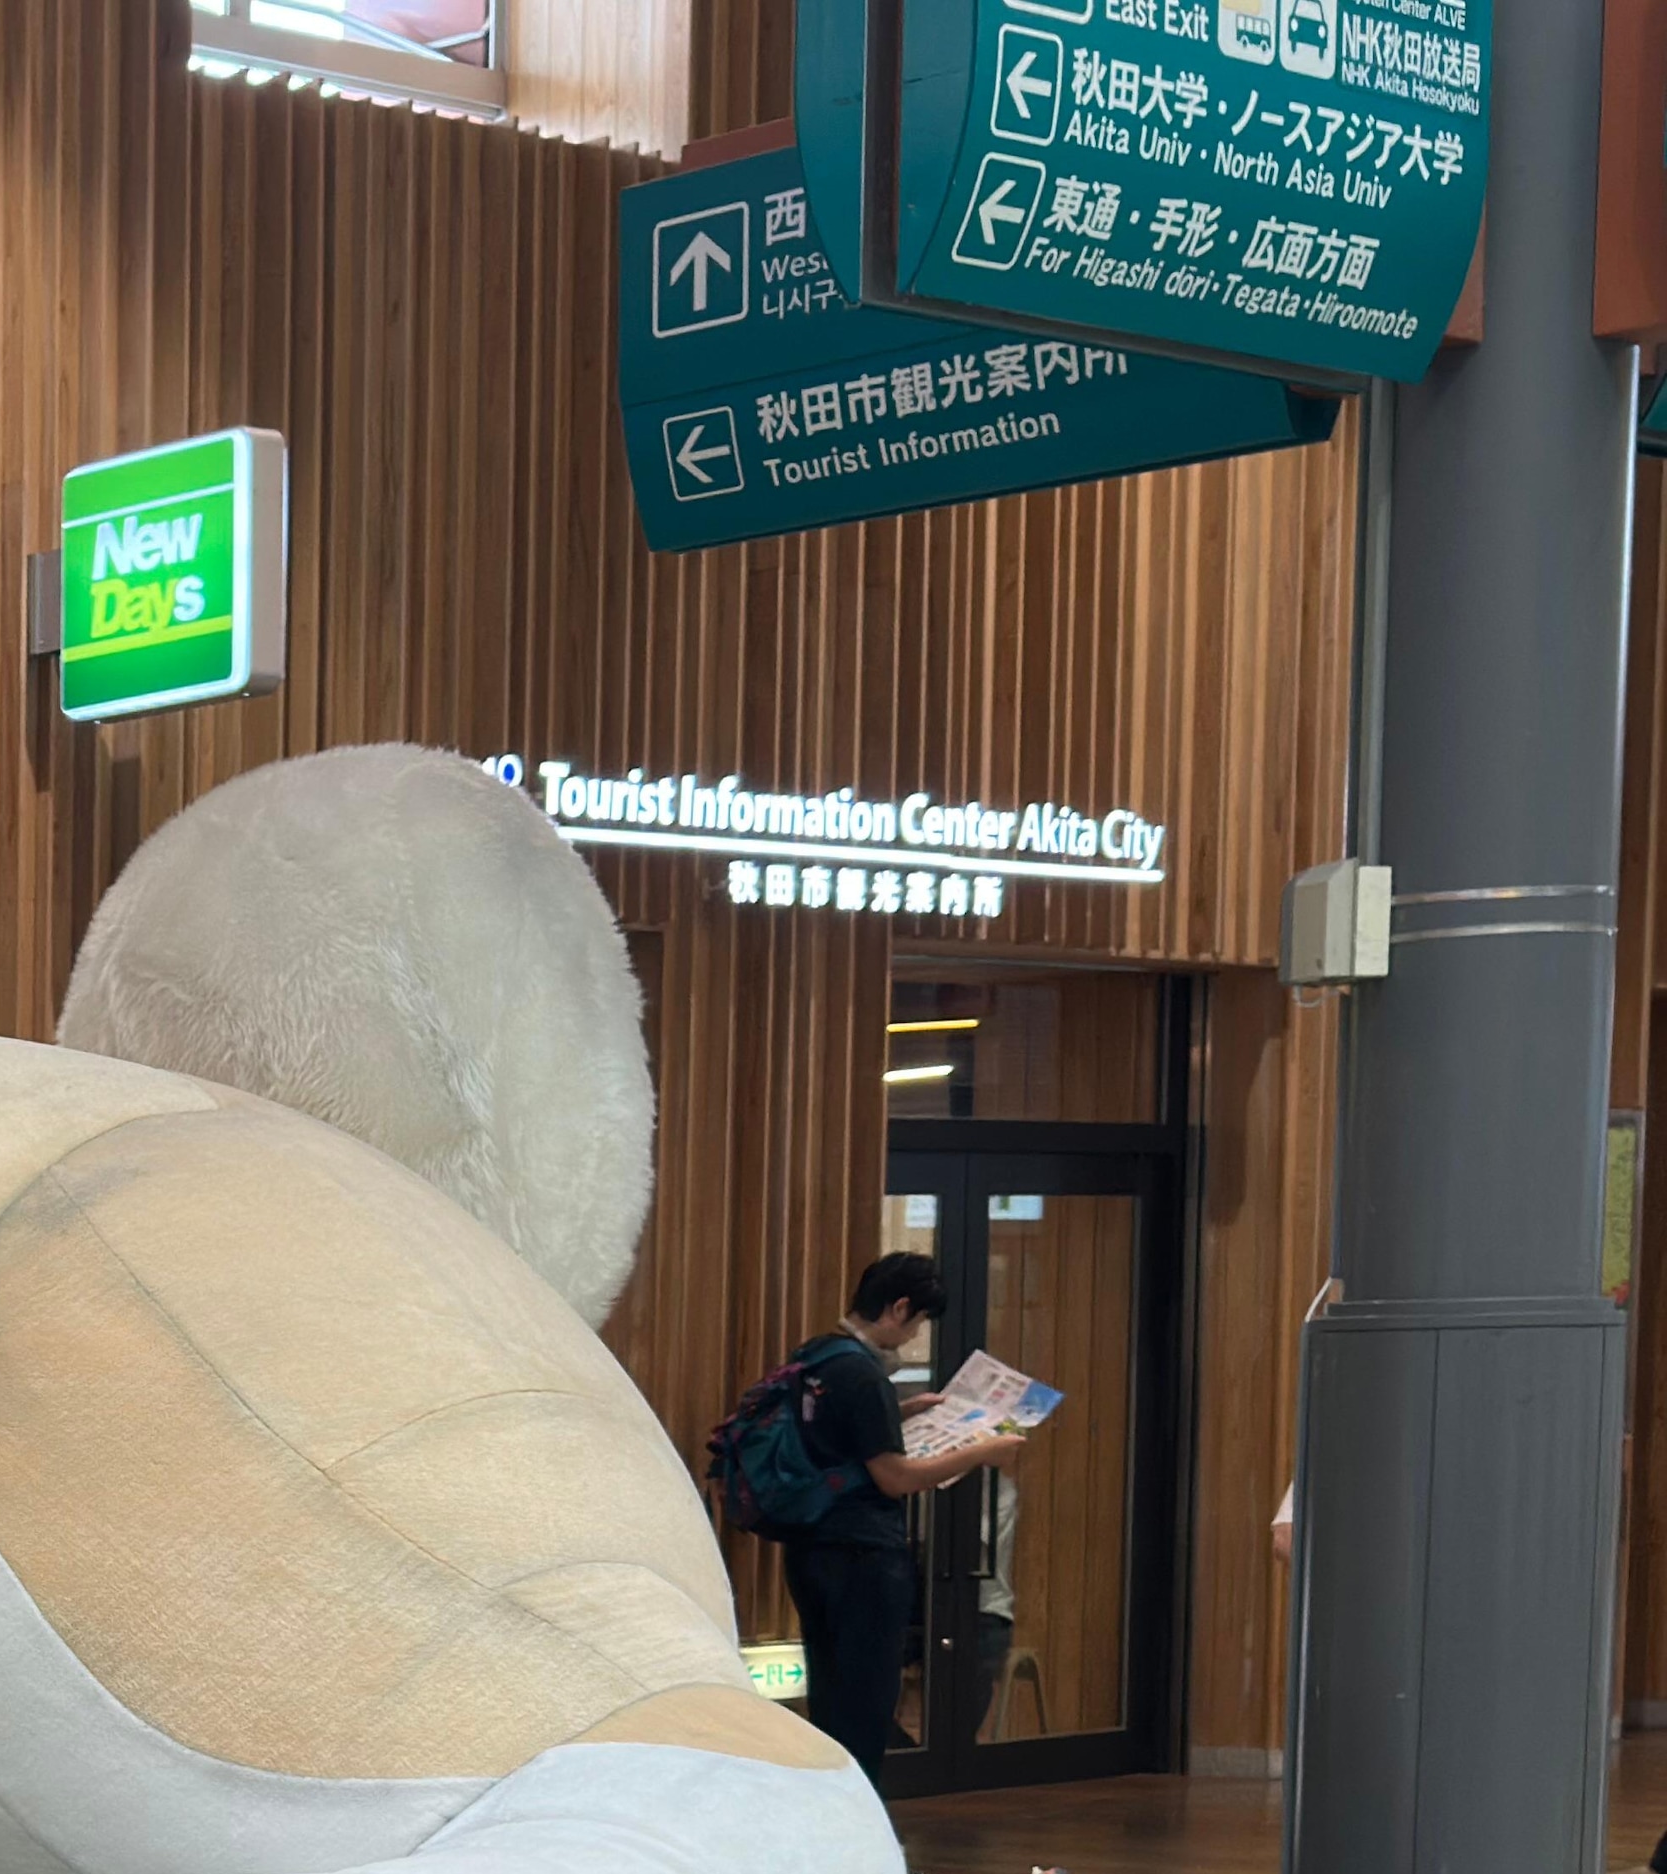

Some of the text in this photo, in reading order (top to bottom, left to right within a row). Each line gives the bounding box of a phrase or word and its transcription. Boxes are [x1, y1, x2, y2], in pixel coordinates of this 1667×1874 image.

[1164, 8, 1210, 42] Exit
[1341, 11, 1482, 93] NHK秋田放送局
[1434, 3, 1466, 31] ALVE
[1342, 60, 1372, 88] NHK
[1374, 68, 1409, 98] Akita
[1071, 46, 1464, 186] 秋田大学・ノースアジア大学
[1064, 110, 1131, 157] Akita
[1138, 134, 1192, 168] Univ
[1214, 142, 1279, 188] North
[1285, 158, 1335, 200] Asia
[1343, 174, 1393, 210] Univ
[1025, 235, 1071, 275] For
[1073, 247, 1161, 294] Higashi
[1043, 176, 1380, 291] 東通・手形・広面方面
[763, 409, 1062, 488] Tourist Information
[91, 513, 204, 581] New
[91, 574, 206, 640] Days
[539, 760, 1166, 873] Tourist Information Center Akita City
